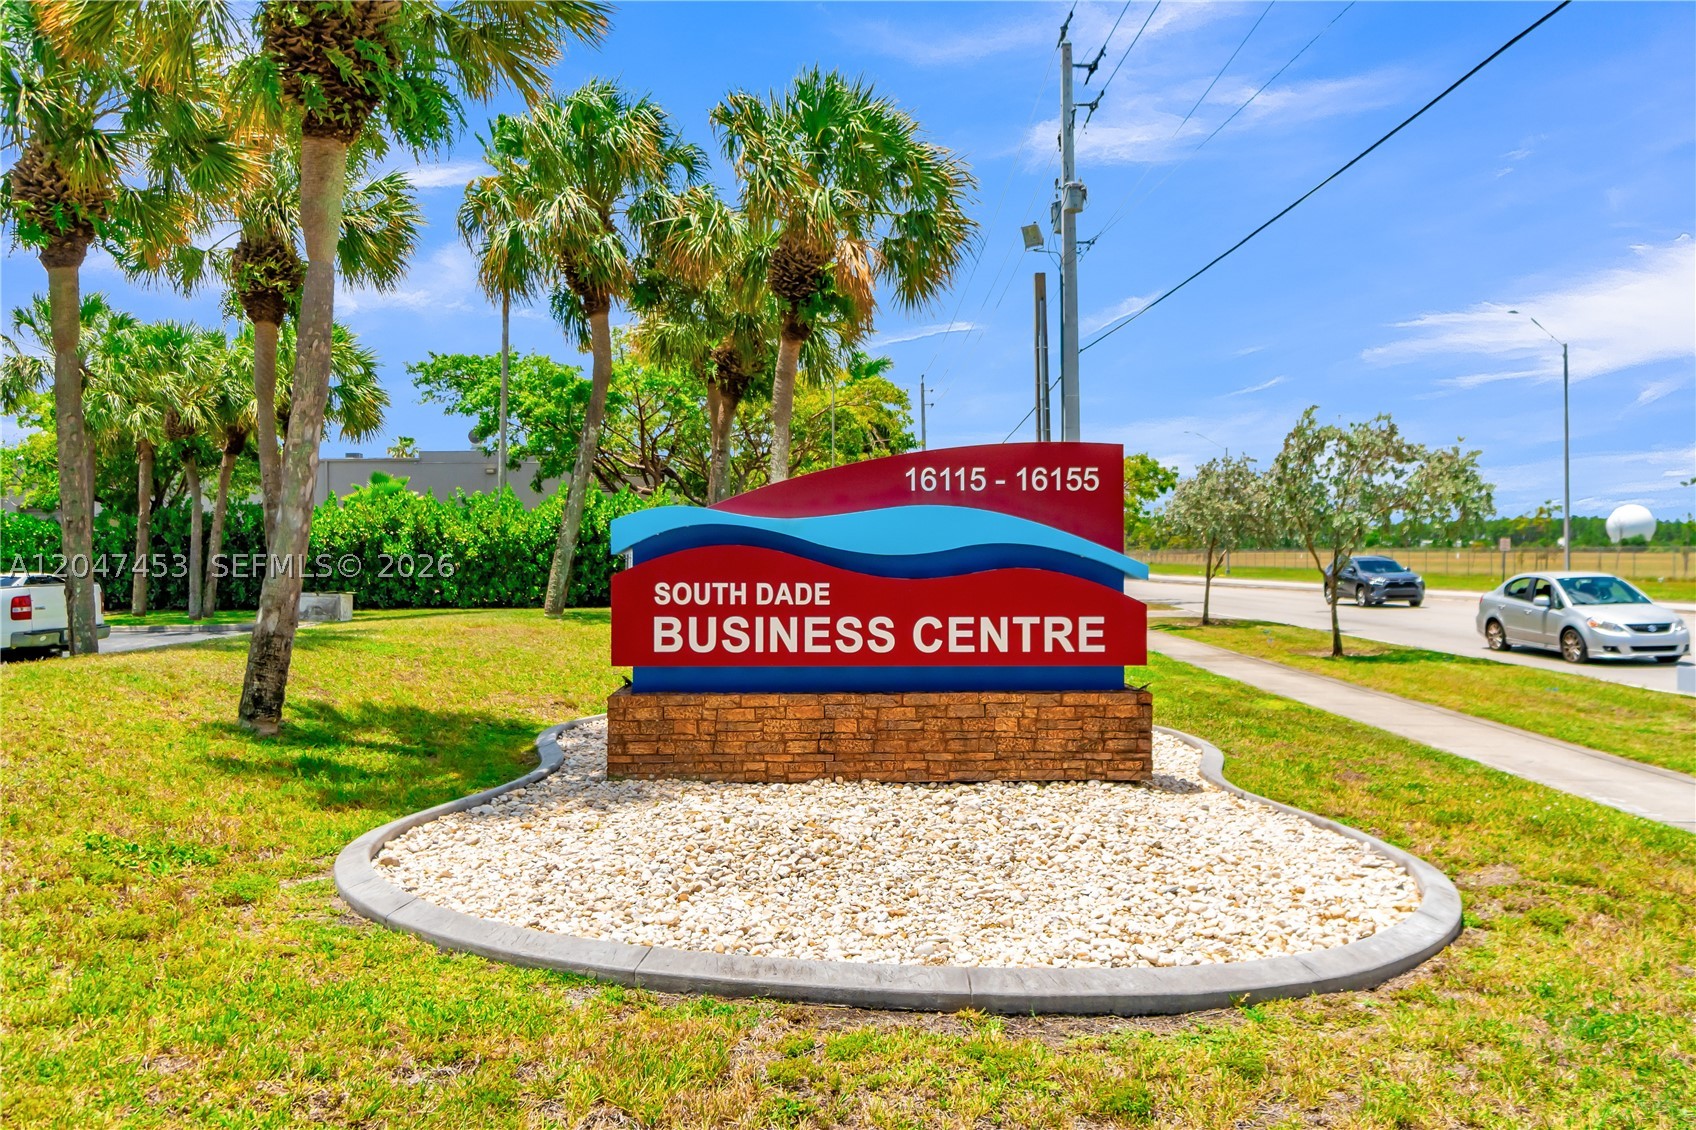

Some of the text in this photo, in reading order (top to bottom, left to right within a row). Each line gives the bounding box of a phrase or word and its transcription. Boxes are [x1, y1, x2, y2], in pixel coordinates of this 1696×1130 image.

[905, 466, 986, 492] 16115
[1016, 466, 1100, 492] 16155
[654, 582, 831, 606] SOUTH DADE
[653, 615, 1106, 654] BUSINESS CENTRE
